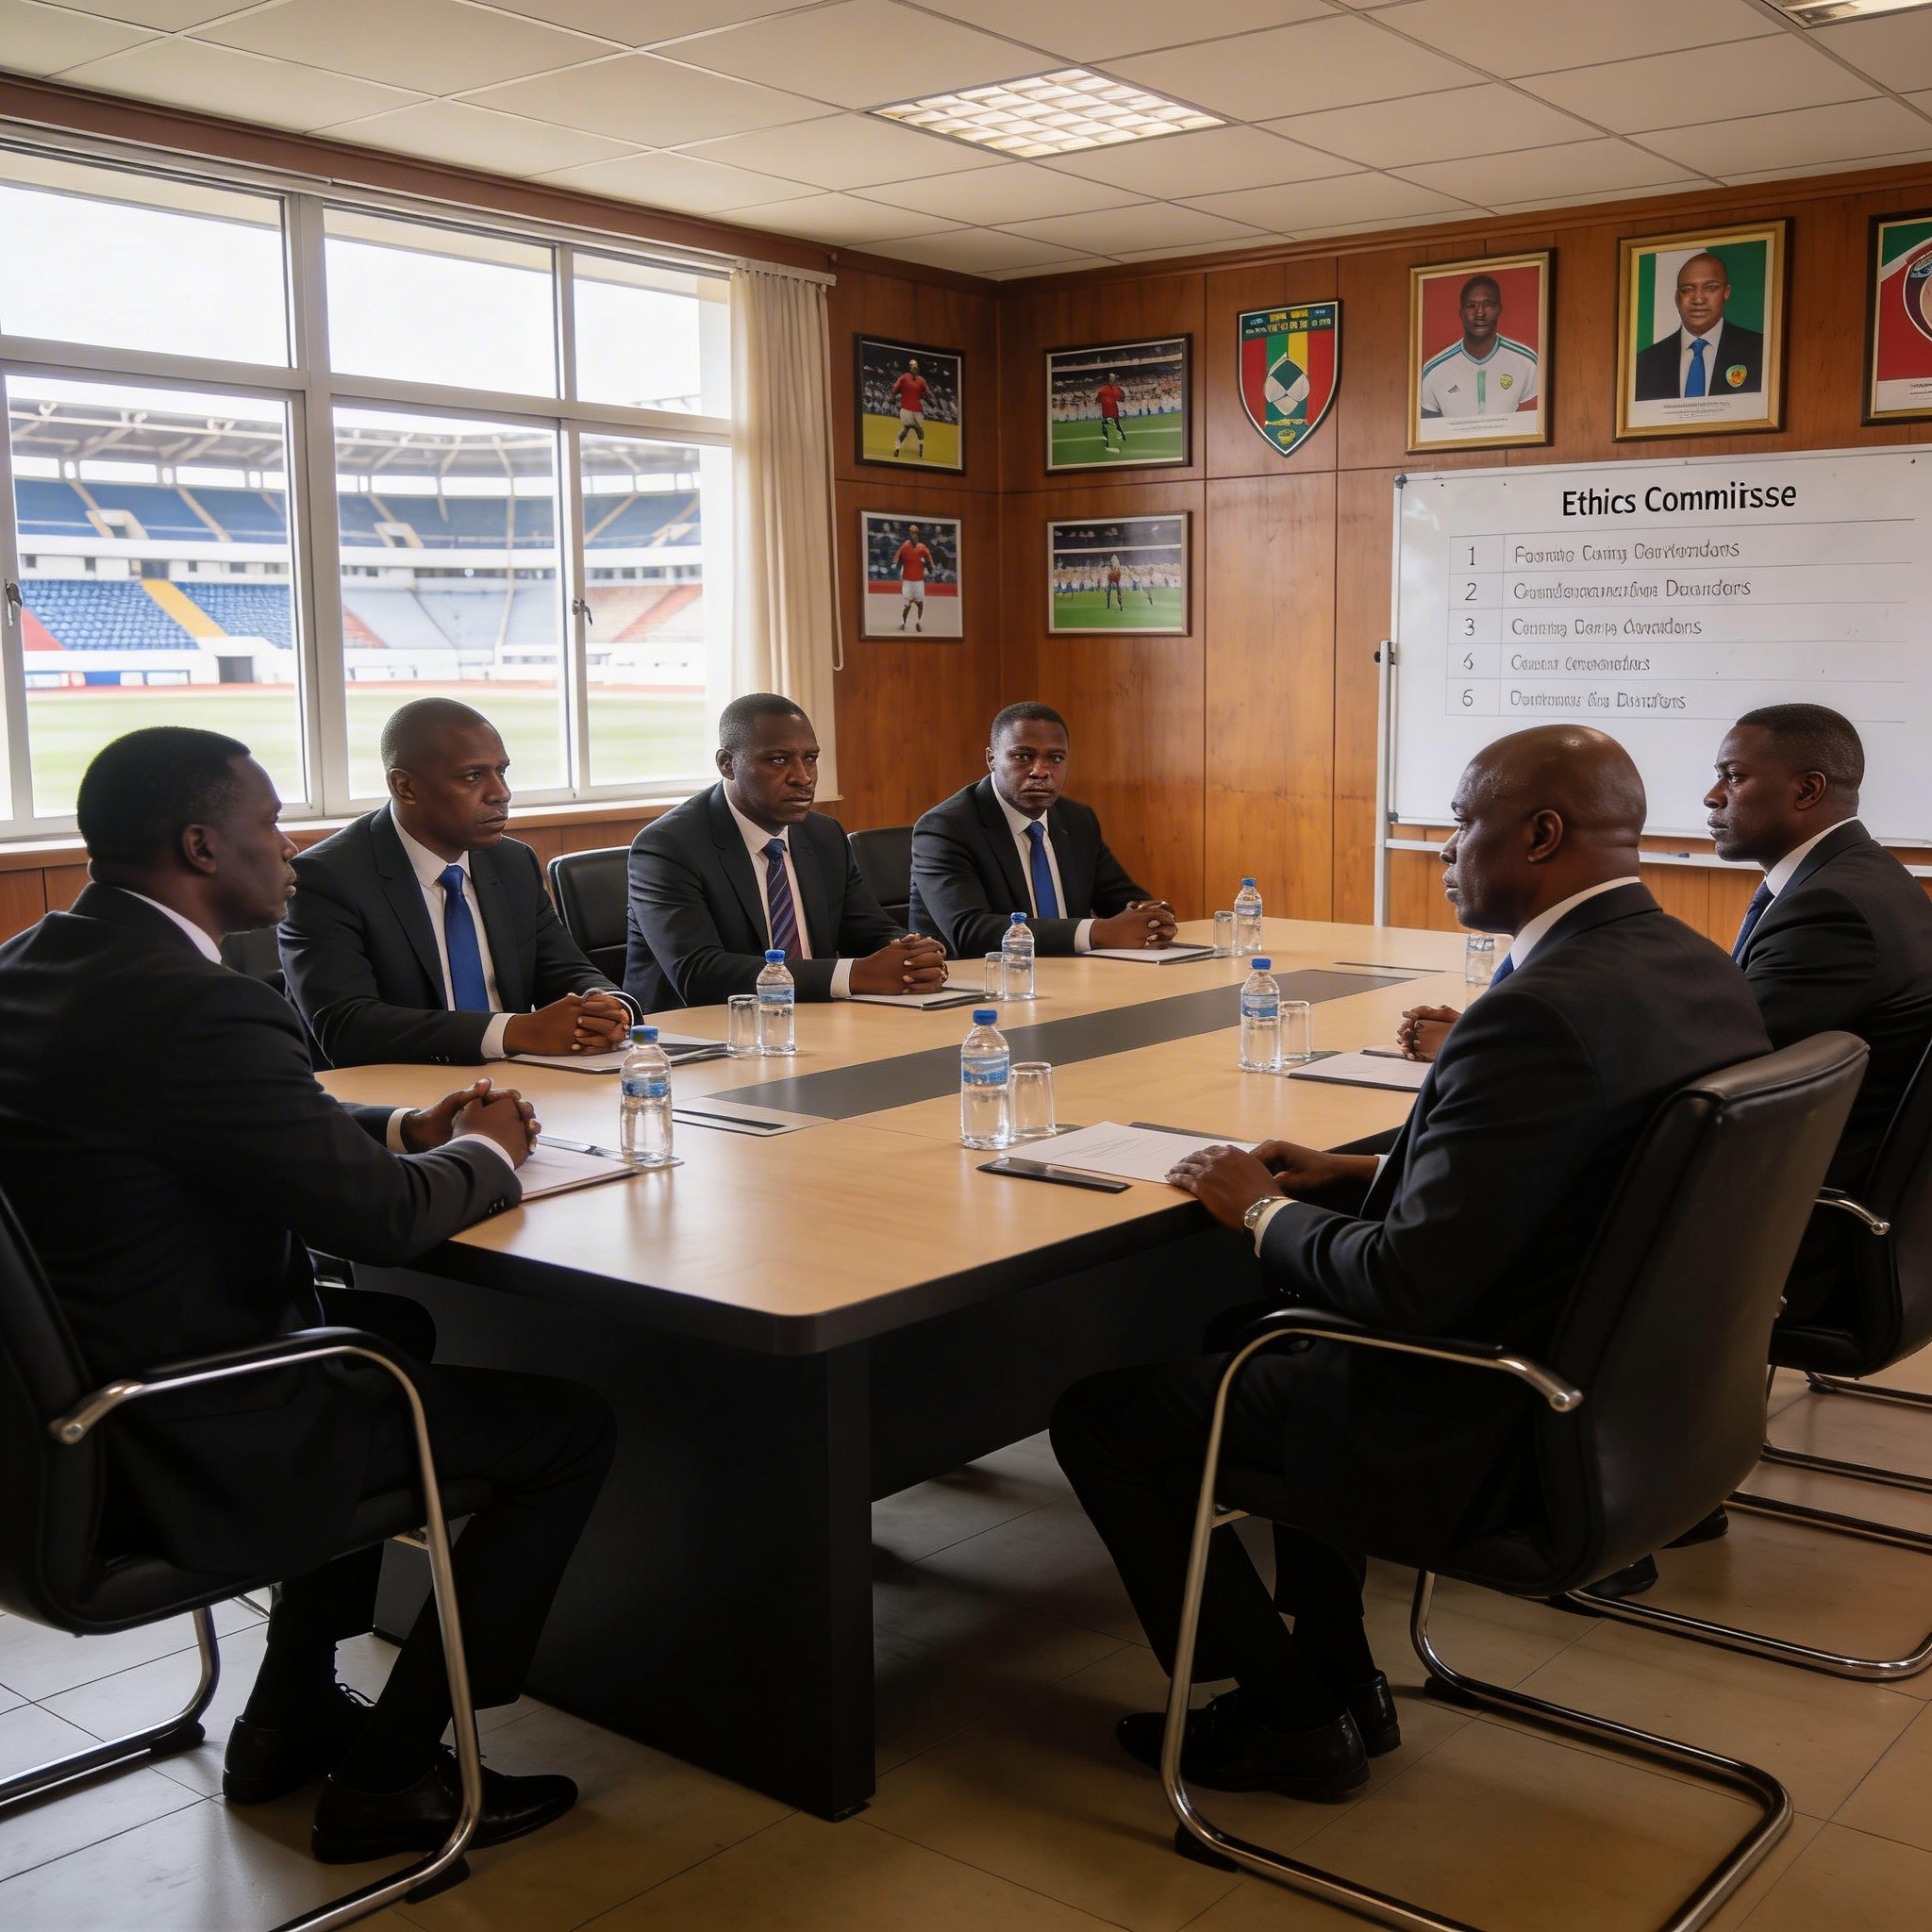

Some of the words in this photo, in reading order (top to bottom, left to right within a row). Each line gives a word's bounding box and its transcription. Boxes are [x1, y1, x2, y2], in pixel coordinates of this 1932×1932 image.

[1561, 487, 1638, 517] Ethics
[1467, 545, 1477, 566] 1
[1464, 581, 1478, 601] 2
[1463, 617, 1475, 637] 3
[1461, 688, 1474, 708] 6
